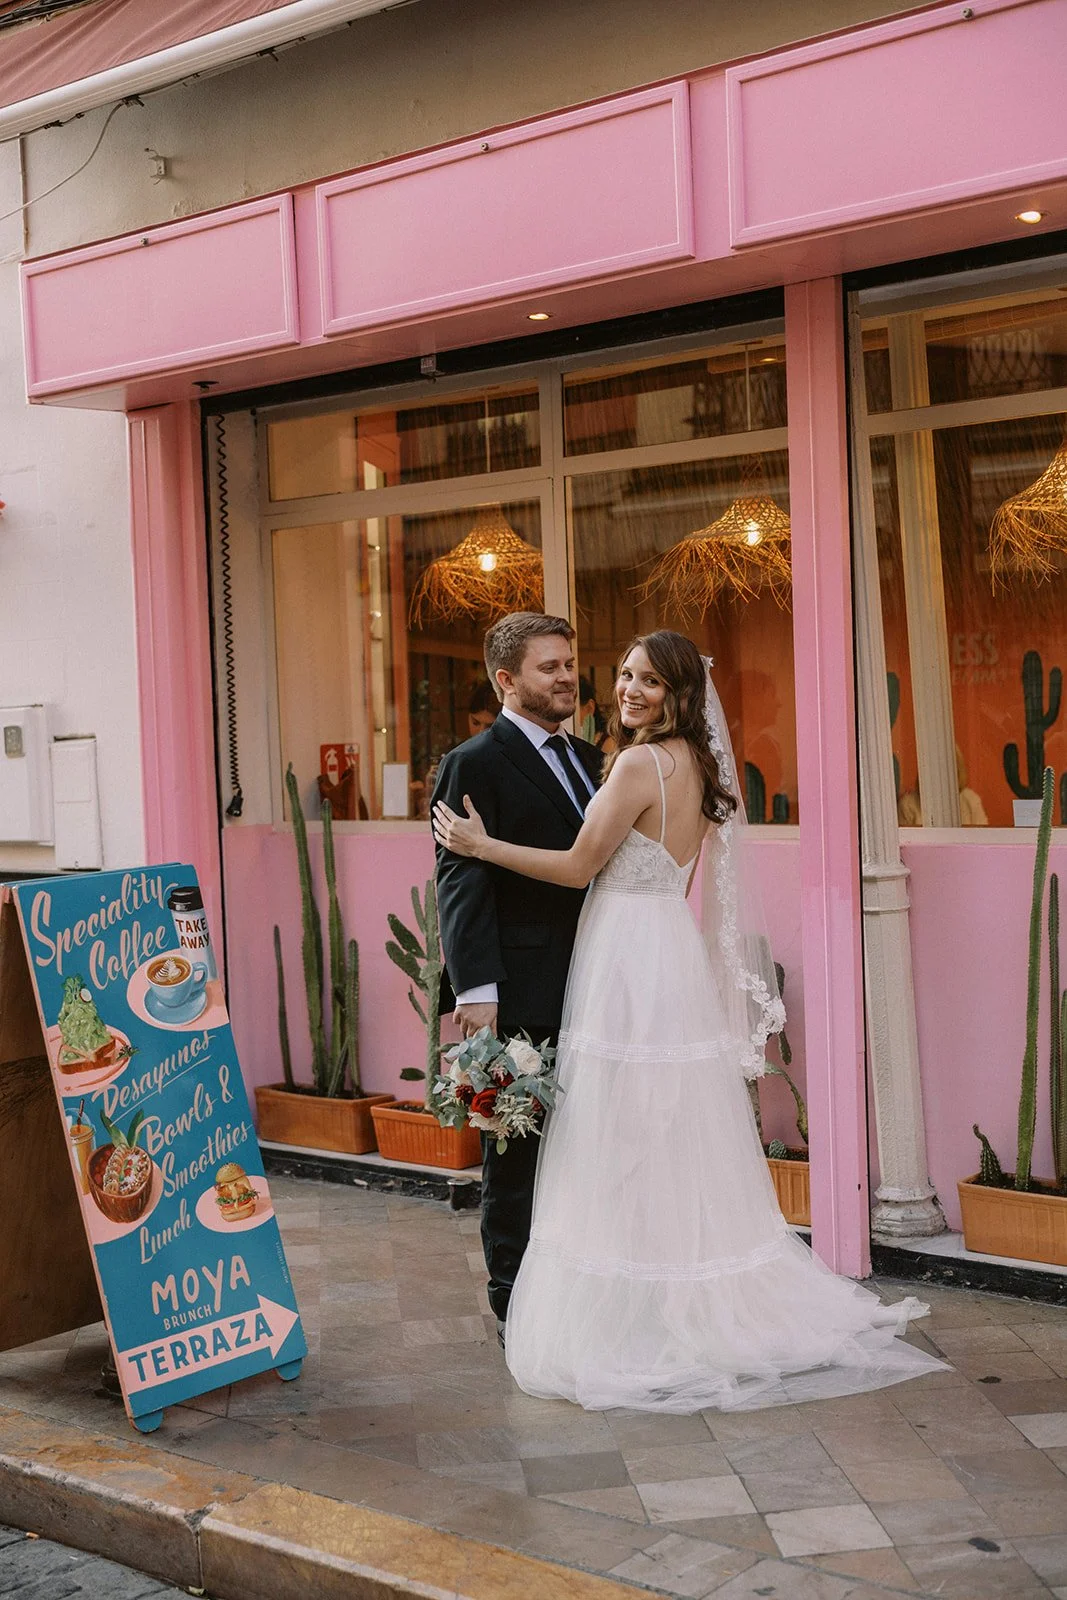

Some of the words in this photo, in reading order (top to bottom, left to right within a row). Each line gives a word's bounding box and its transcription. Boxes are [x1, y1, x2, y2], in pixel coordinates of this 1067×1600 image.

[30, 872, 180, 976] Speciality
[89, 920, 171, 991] Coffee
[175, 917, 208, 933] TAKE
[180, 932, 210, 949] AWAY
[91, 1029, 217, 1118] Desayunos
[134, 1083, 217, 1156] Bowls
[218, 1064, 234, 1104] &
[161, 1120, 253, 1198] Smoothies
[139, 1198, 193, 1265] Lunch
[151, 1254, 251, 1316] MOYA
[163, 1302, 213, 1331] BRUNCH
[127, 1312, 273, 1383] TERRAZA
